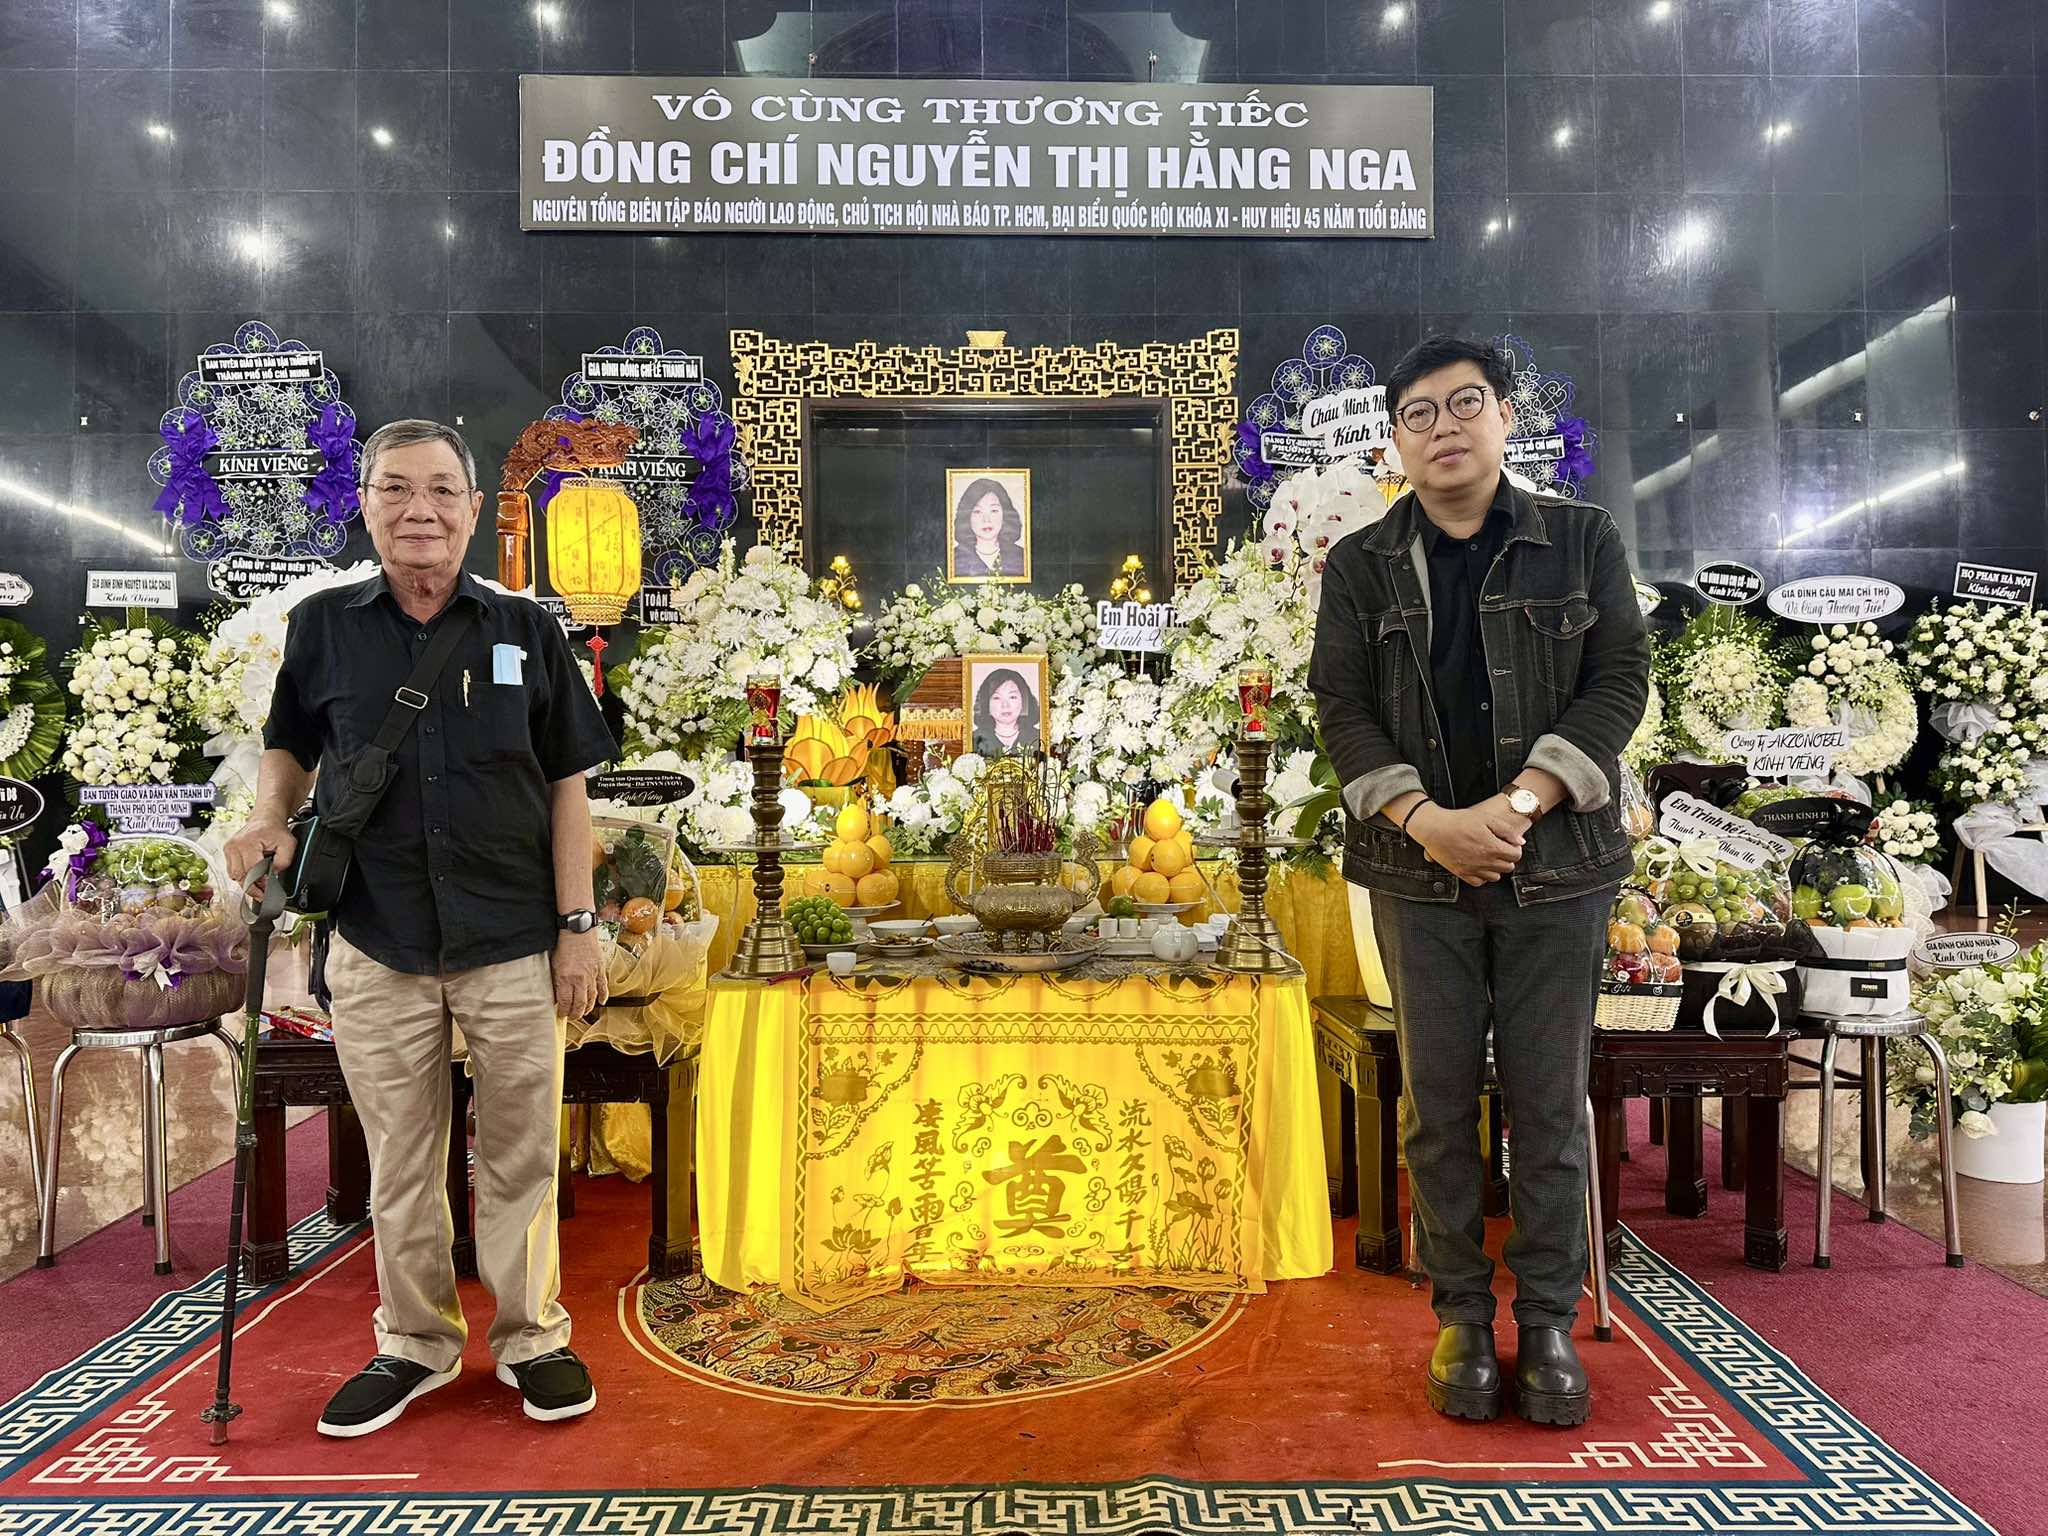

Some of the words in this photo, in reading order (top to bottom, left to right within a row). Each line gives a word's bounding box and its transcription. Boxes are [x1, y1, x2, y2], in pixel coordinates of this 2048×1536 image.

[652, 88, 731, 121] VÔ
[751, 89, 906, 123] CÙNG
[922, 96, 1163, 126] THƯƠNG
[1180, 89, 1311, 128] TIẾC
[542, 126, 691, 184] ĐỒNG
[711, 134, 798, 185] CHÍ
[817, 130, 1031, 187] NGUYỄN
[1048, 146, 1128, 197] THỊ
[1148, 131, 1291, 190] HẰNG
[1310, 148, 1417, 191] NGA
[533, 195, 587, 222] NGUYÊN
[590, 192, 625, 222] TỔNG
[629, 196, 661, 223] BIÊN
[665, 197, 691, 228] TẬP
[694, 197, 721, 223] BÁO
[725, 197, 765, 225] NGƯỜI
[770, 202, 794, 225] LAO
[798, 198, 839, 229] ĐỘNG,
[842, 196, 869, 225] CHỦ
[872, 203, 901, 230] TỊCH
[906, 199, 928, 230] HỘI
[932, 200, 960, 226] NHÀ
[963, 200, 989, 227] BÁO
[993, 205, 1011, 227] TP.
[1015, 205, 1049, 230] HCM,
[1052, 205, 1075, 232] ĐẠI
[1078, 197, 1109, 228] BIỂU
[1112, 198, 1147, 231] QUỐC
[1151, 202, 1173, 233] HỘI
[1176, 202, 1212, 229] KHÓA
[1215, 206, 1229, 228] XI
[1241, 207, 1267, 229] HUY
[1271, 203, 1300, 233] HIỆU
[1304, 208, 1320, 229] 45
[1324, 203, 1354, 229] NĂM
[1358, 200, 1386, 229] TUỔI
[1390, 201, 1426, 230] ĐẢNG
[216, 370, 243, 381] THÀNH
[244, 369, 260, 380] PHỐ
[262, 369, 273, 380] HỒ
[275, 367, 289, 379] CHÍ
[290, 368, 310, 378] MINH
[588, 361, 600, 376] GIA
[601, 359, 619, 377] ĐÌNH
[1311, 403, 1339, 428] Cháu
[1342, 396, 1370, 416] Minh
[1333, 423, 1371, 447] Kính
[219, 455, 259, 472] KÍNH
[261, 453, 308, 472] VIẾNG
[640, 457, 686, 477] VIẾNG
[232, 557, 253, 570] ĐẢNG
[255, 558, 264, 570] ỦY
[271, 562, 286, 571] BAN
[288, 561, 306, 572] BIÊN
[92, 578, 100, 589] GIA
[228, 571, 246, 582] BÁO
[249, 572, 277, 584] NGƯỜI
[1961, 569, 1975, 580] HỌ
[1976, 571, 2000, 583] PHAN
[2000, 573, 2013, 584] HÀ
[2014, 575, 2032, 588] NỘI
[1781, 589, 1795, 598] GIA
[1798, 586, 1816, 598] ĐÌNH
[1838, 587, 1854, 597] MAI
[1856, 585, 1871, 597] CHÍ
[1967, 582, 1990, 595] Kính
[645, 592, 668, 607] TOÀN
[661, 611, 679, 622] CÙNG
[1101, 605, 1121, 626] Em
[1126, 605, 1159, 627] Hoài
[1106, 628, 1142, 647] Kính
[1730, 734, 1755, 752] Công
[1767, 731, 1845, 748] AKZONOBEL
[1753, 753, 1784, 771] KÍNH
[83, 790, 97, 800] BAN
[99, 788, 118, 799] TUYÊN
[121, 787, 137, 799] GIÁO
[150, 787, 163, 799] DÂN
[110, 802, 130, 814] THÀNH
[132, 801, 145, 814] PHỐ
[148, 801, 157, 814] HỒ
[159, 801, 169, 813] CHÍ
[171, 803, 188, 813] MINH
[1669, 798, 1692, 813] Em
[1926, 942, 1938, 951] GIA
[1938, 940, 1955, 950] ĐÌNH
[1955, 937, 1974, 949] CHÁU
[1932, 952, 1955, 963] Kính
[982, 1134, 1088, 1239] 奠
